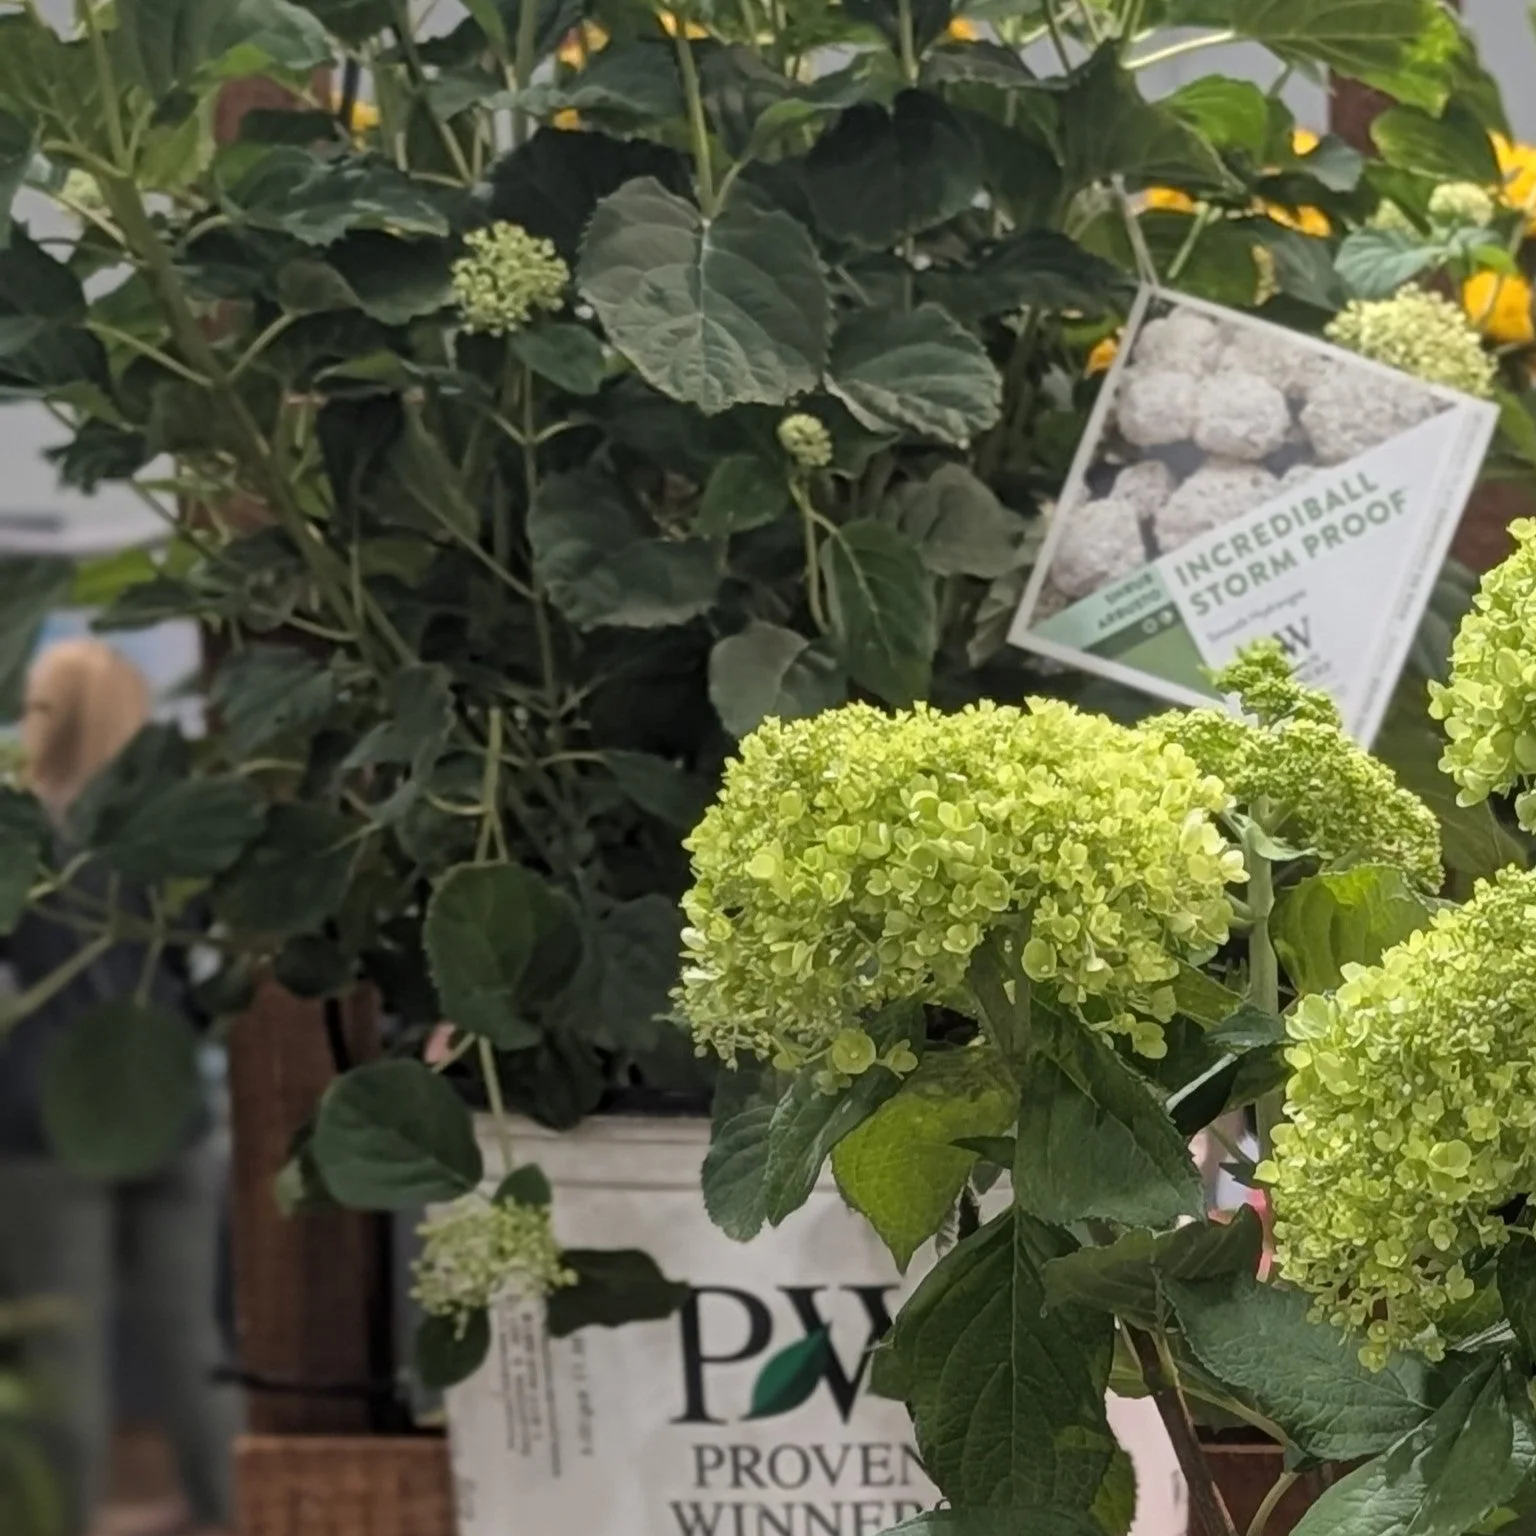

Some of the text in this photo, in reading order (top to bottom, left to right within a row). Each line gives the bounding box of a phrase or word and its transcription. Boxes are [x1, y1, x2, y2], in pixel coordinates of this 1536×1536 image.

[1174, 472, 1379, 586] INCREDIBALL
[1189, 487, 1409, 616] STORM PROOF
